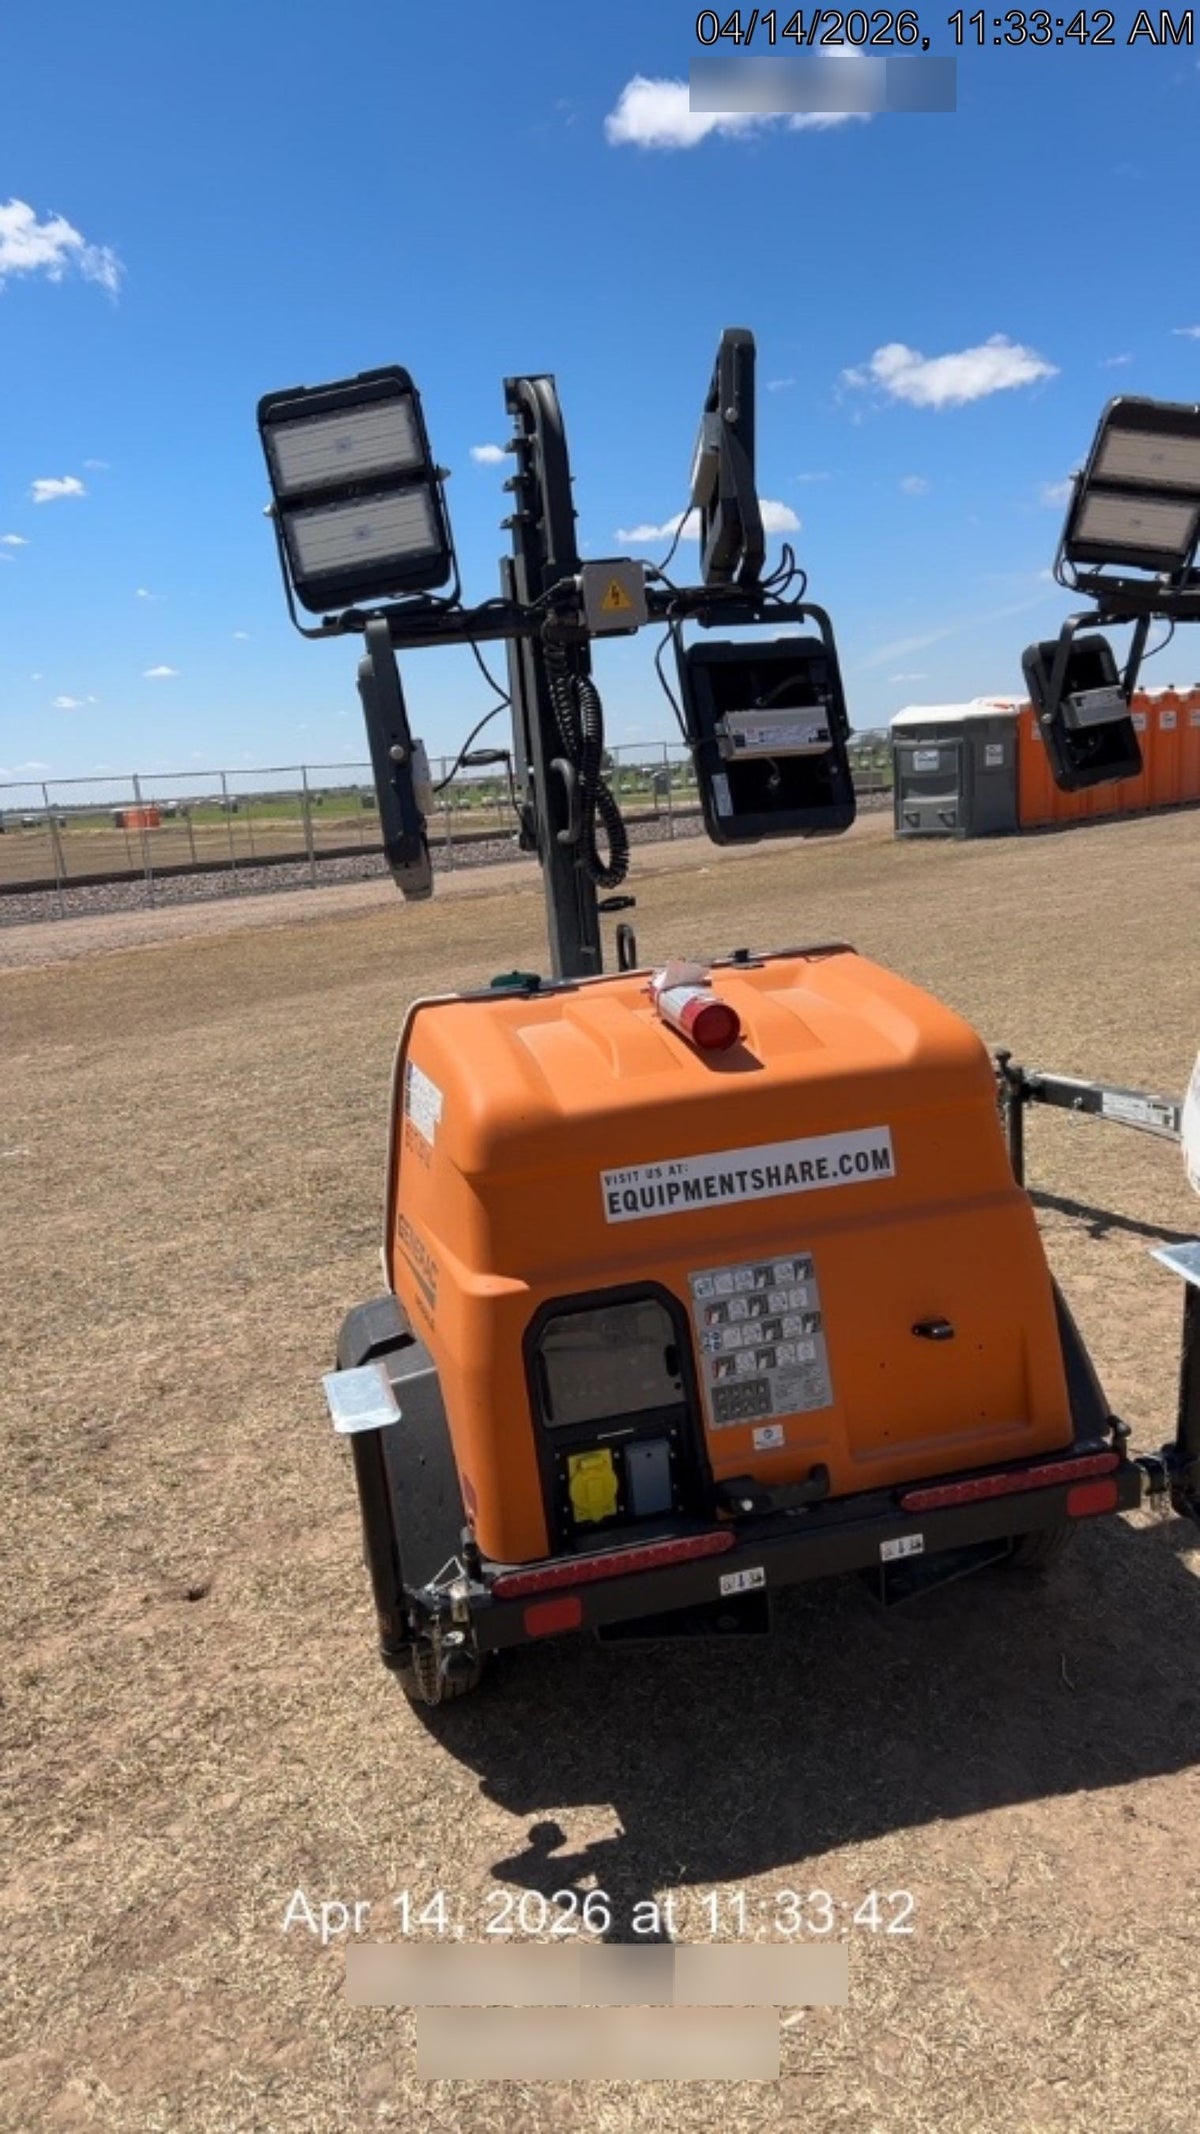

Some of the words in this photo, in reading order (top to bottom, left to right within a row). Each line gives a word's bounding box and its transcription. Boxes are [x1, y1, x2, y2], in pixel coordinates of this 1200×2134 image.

[604, 1171, 639, 1186] VISIT
[645, 1166, 662, 1179] US
[668, 1163, 689, 1176] AT:
[607, 1147, 891, 1215] EQUIPMENTSHARE.COM
